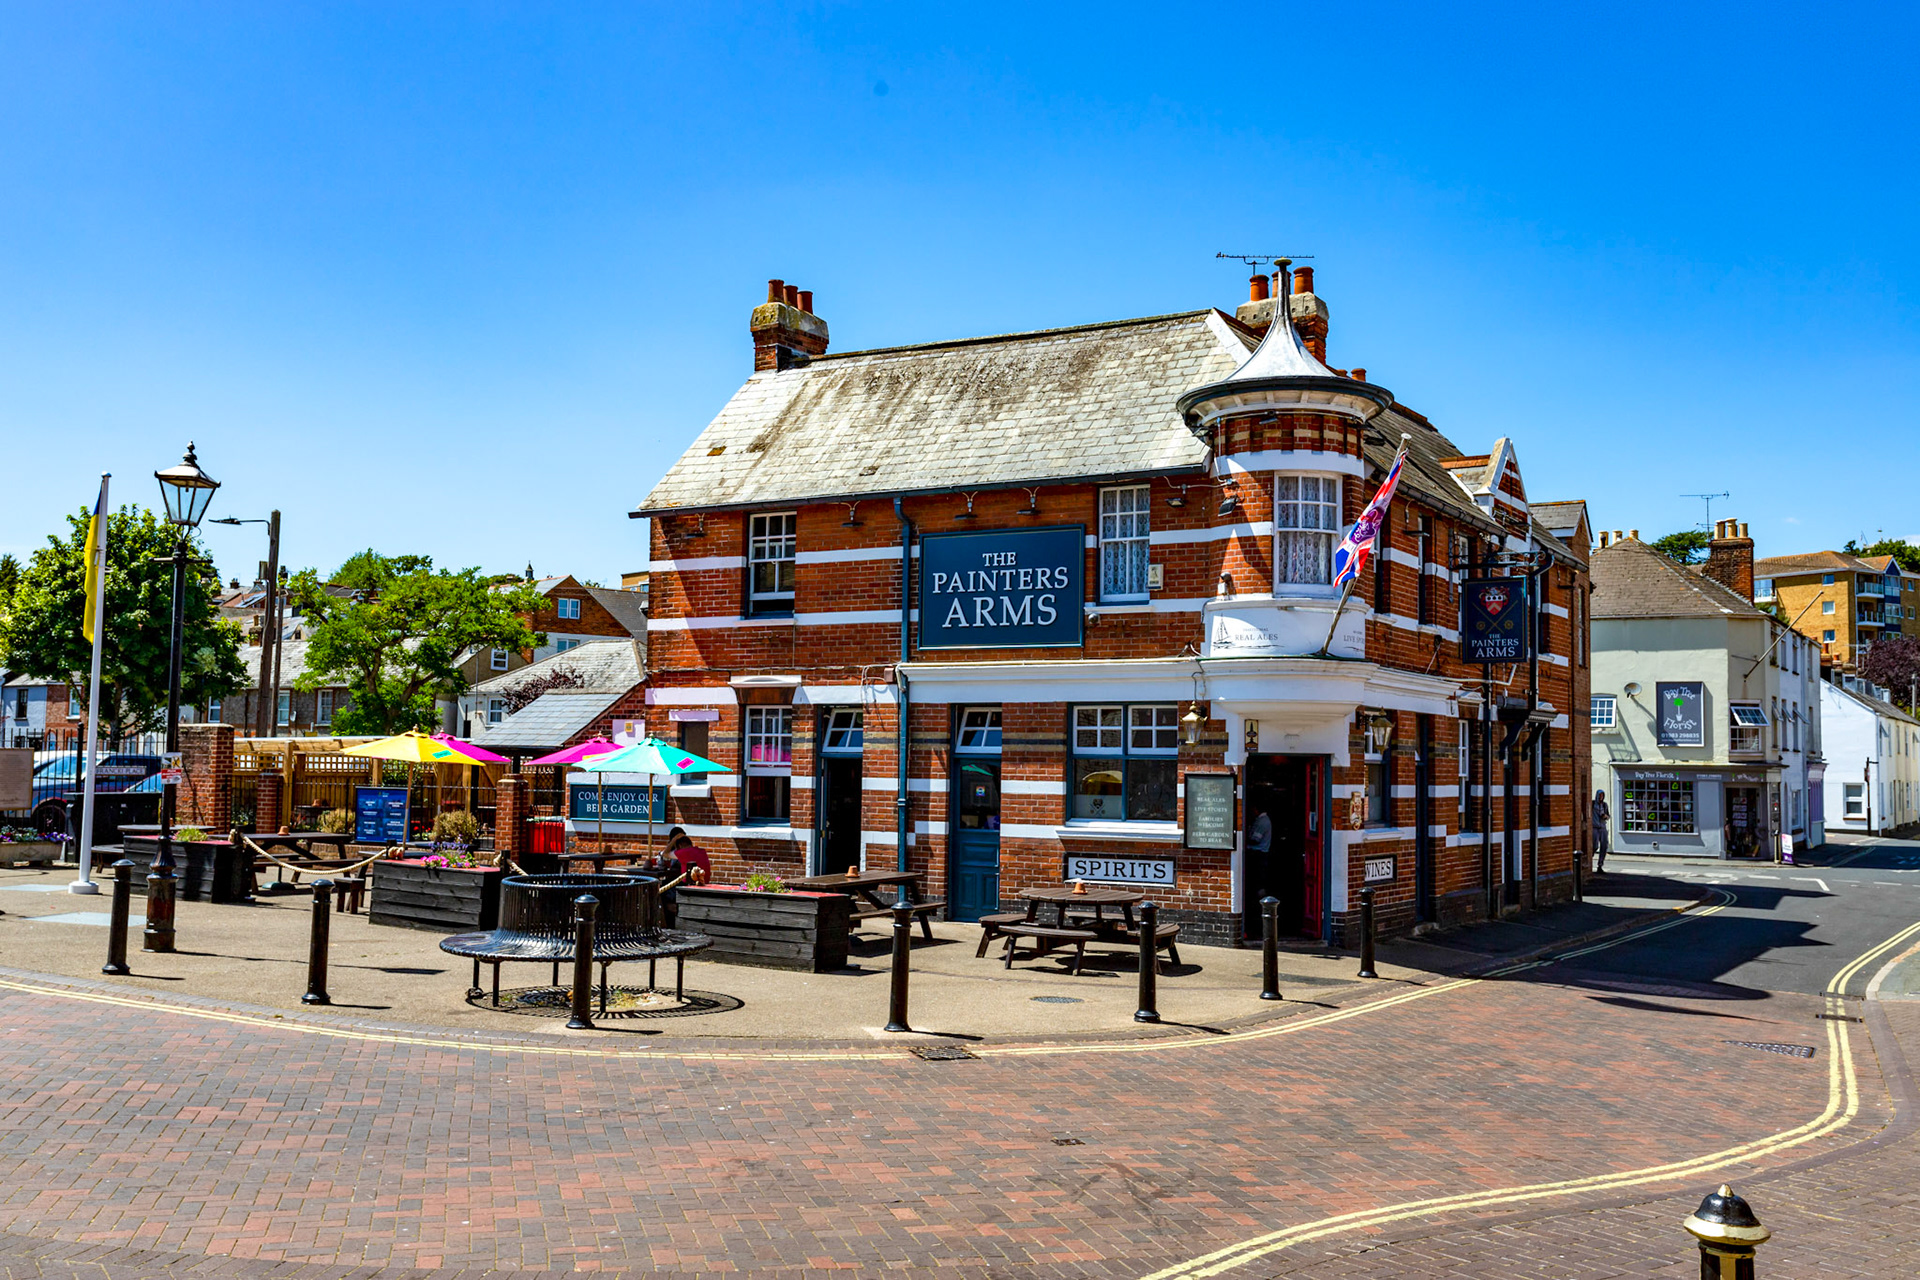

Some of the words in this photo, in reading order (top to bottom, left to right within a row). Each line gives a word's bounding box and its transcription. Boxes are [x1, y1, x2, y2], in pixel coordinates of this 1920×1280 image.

[982, 552, 1017, 567] THE
[932, 566, 1069, 594] PAINTERS
[941, 593, 1058, 628] ARMS
[1257, 633, 1279, 641] ALES
[1471, 638, 1520, 648] PAINTERS
[1475, 646, 1516, 658] ARMS
[1663, 688, 1680, 700] Bay
[1679, 686, 1696, 700] Tree
[1663, 717, 1697, 730] Florist
[578, 791, 604, 801] COME
[607, 792, 636, 803] ENJOY
[610, 804, 650, 814] GARDEN
[1074, 860, 1167, 879] SPIRITS
[1364, 860, 1392, 878] WINES
